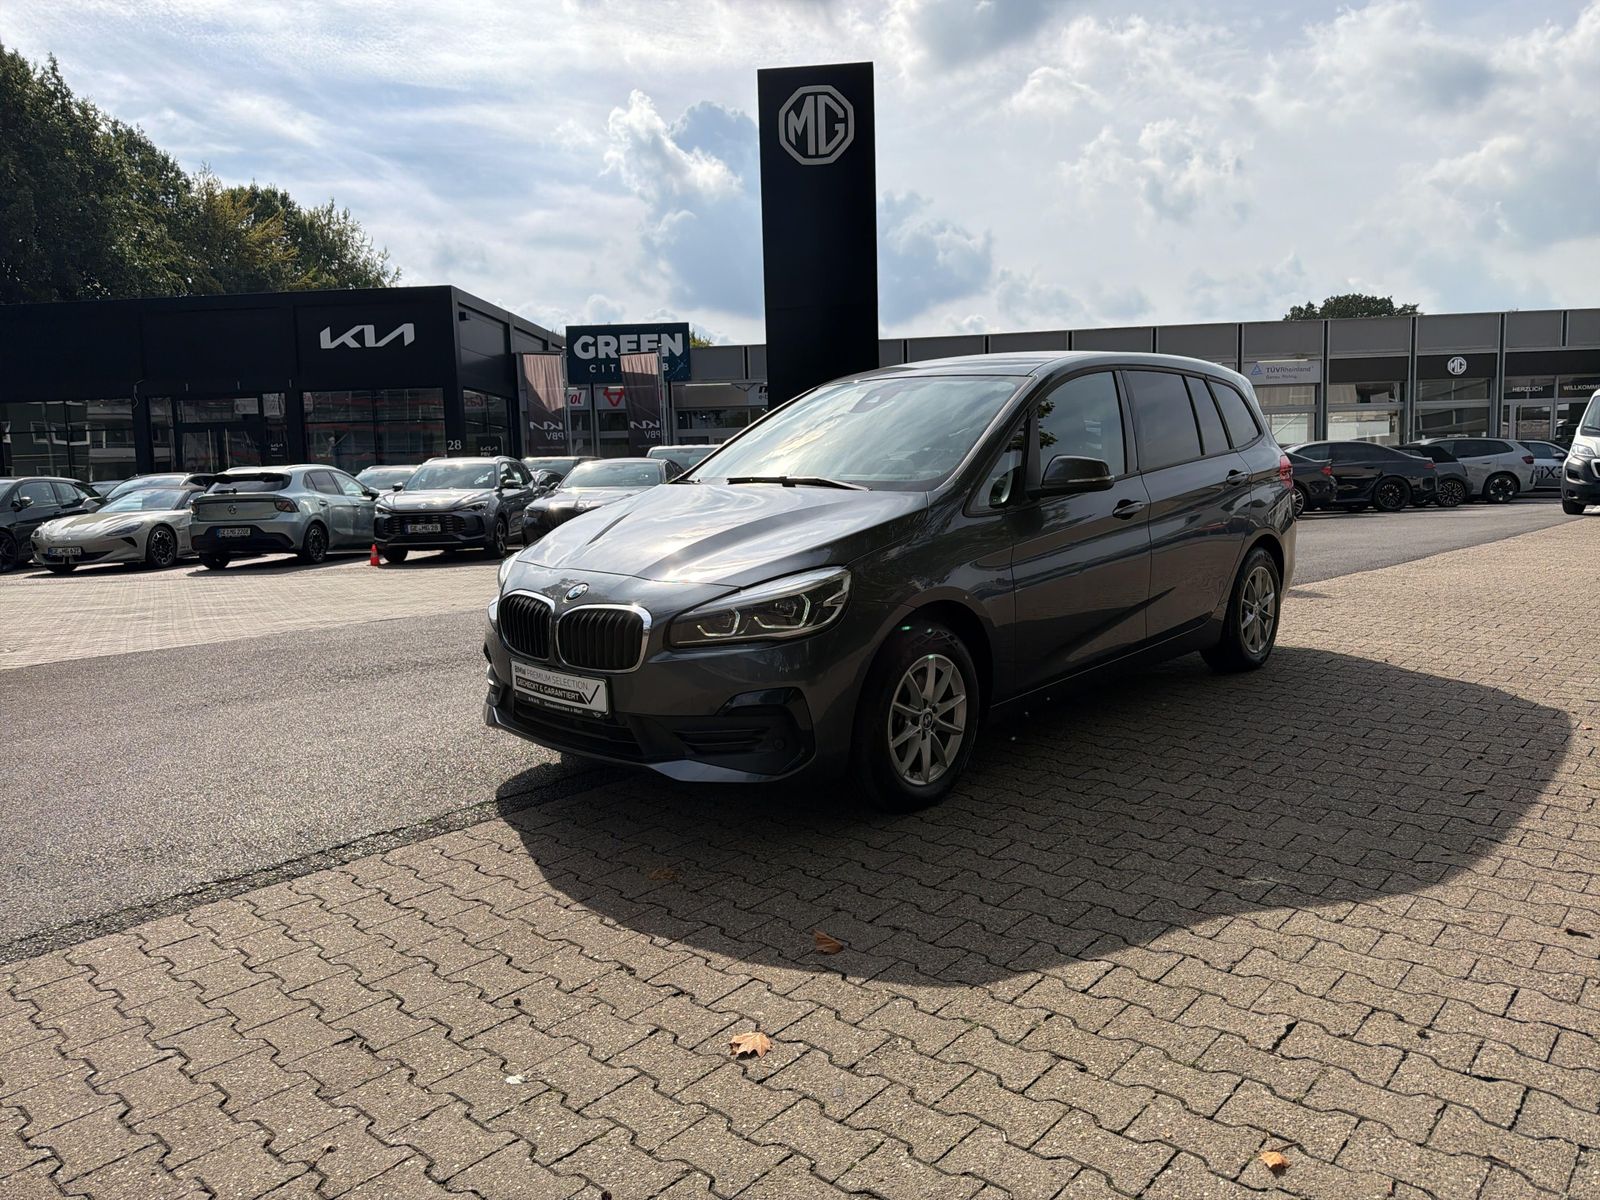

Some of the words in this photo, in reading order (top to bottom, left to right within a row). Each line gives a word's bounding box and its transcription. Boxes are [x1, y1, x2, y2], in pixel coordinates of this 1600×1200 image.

[786, 93, 847, 158] MG
[319, 322, 415, 349] KIA
[573, 333, 684, 359] GREEN
[589, 364, 617, 373] CIT
[1448, 357, 1466, 374] MG
[447, 439, 462, 450] 28
[514, 665, 526, 675] BMW
[527, 669, 552, 682] PREMIUM
[552, 676, 588, 690] SELECTION
[544, 685, 580, 701] GARANTIERT
